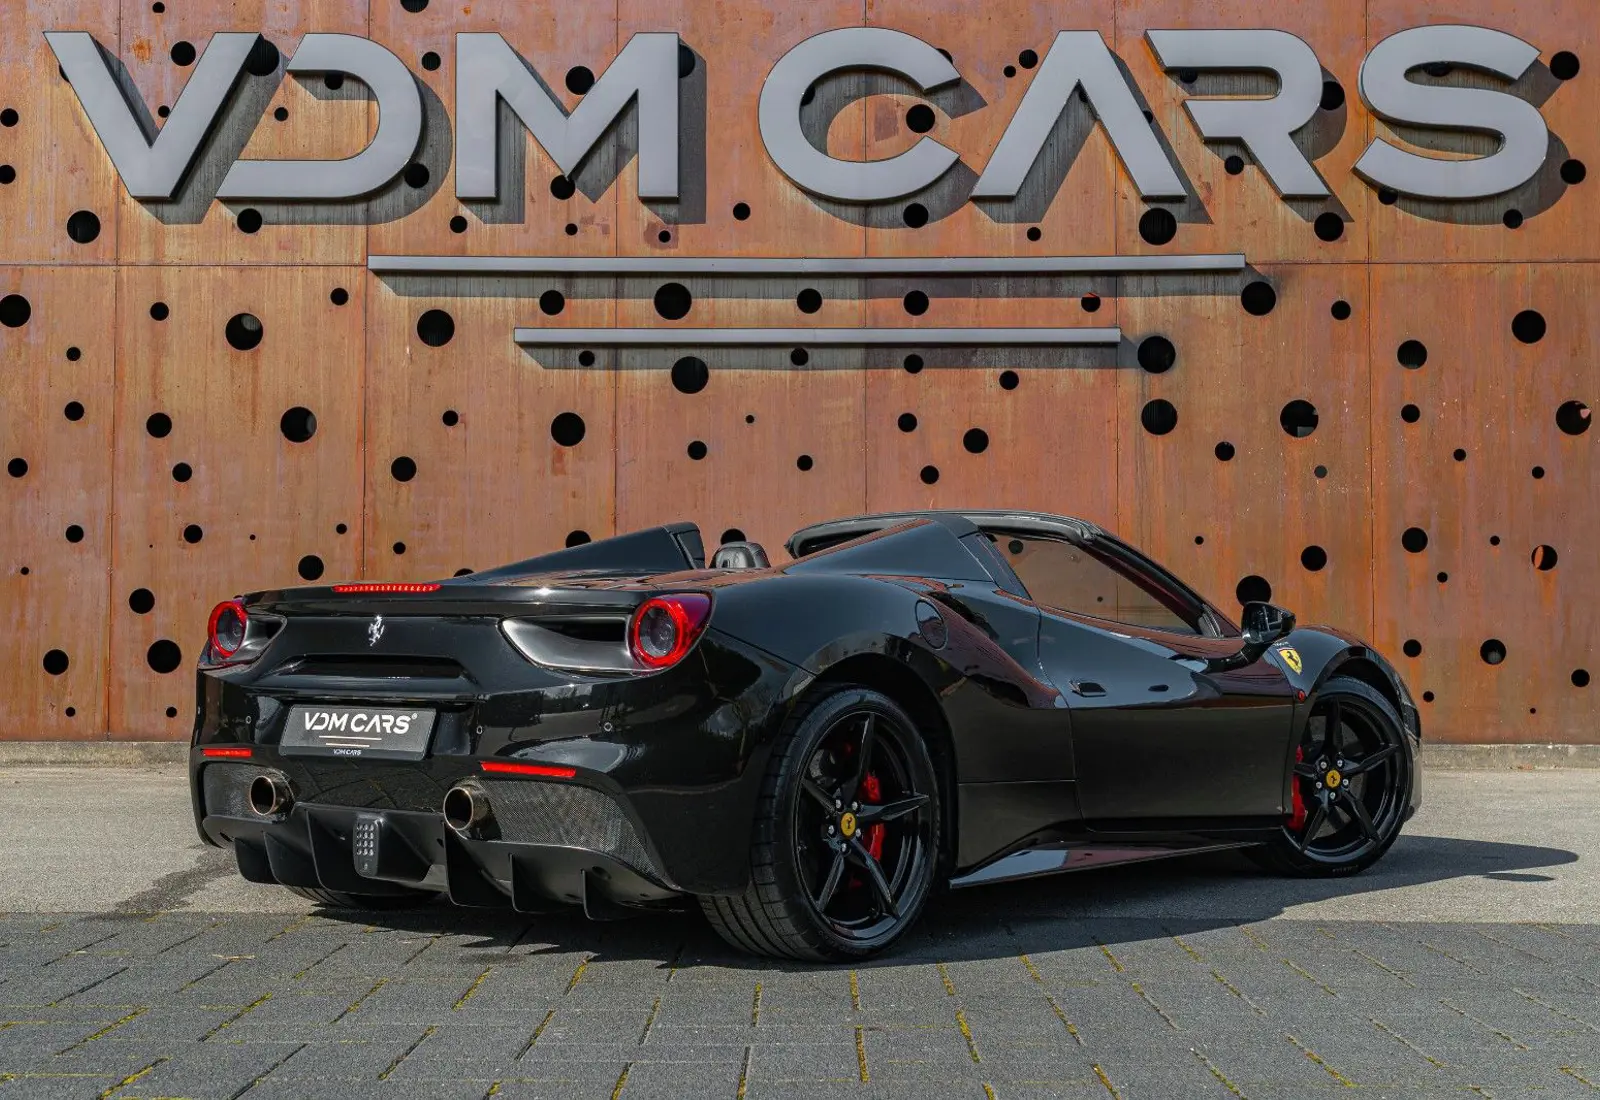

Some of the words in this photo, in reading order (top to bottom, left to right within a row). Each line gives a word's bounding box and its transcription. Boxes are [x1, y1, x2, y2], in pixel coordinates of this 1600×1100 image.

[42, 31, 680, 200] VDM
[757, 24, 1549, 201] CARS
[304, 711, 349, 732] VDM
